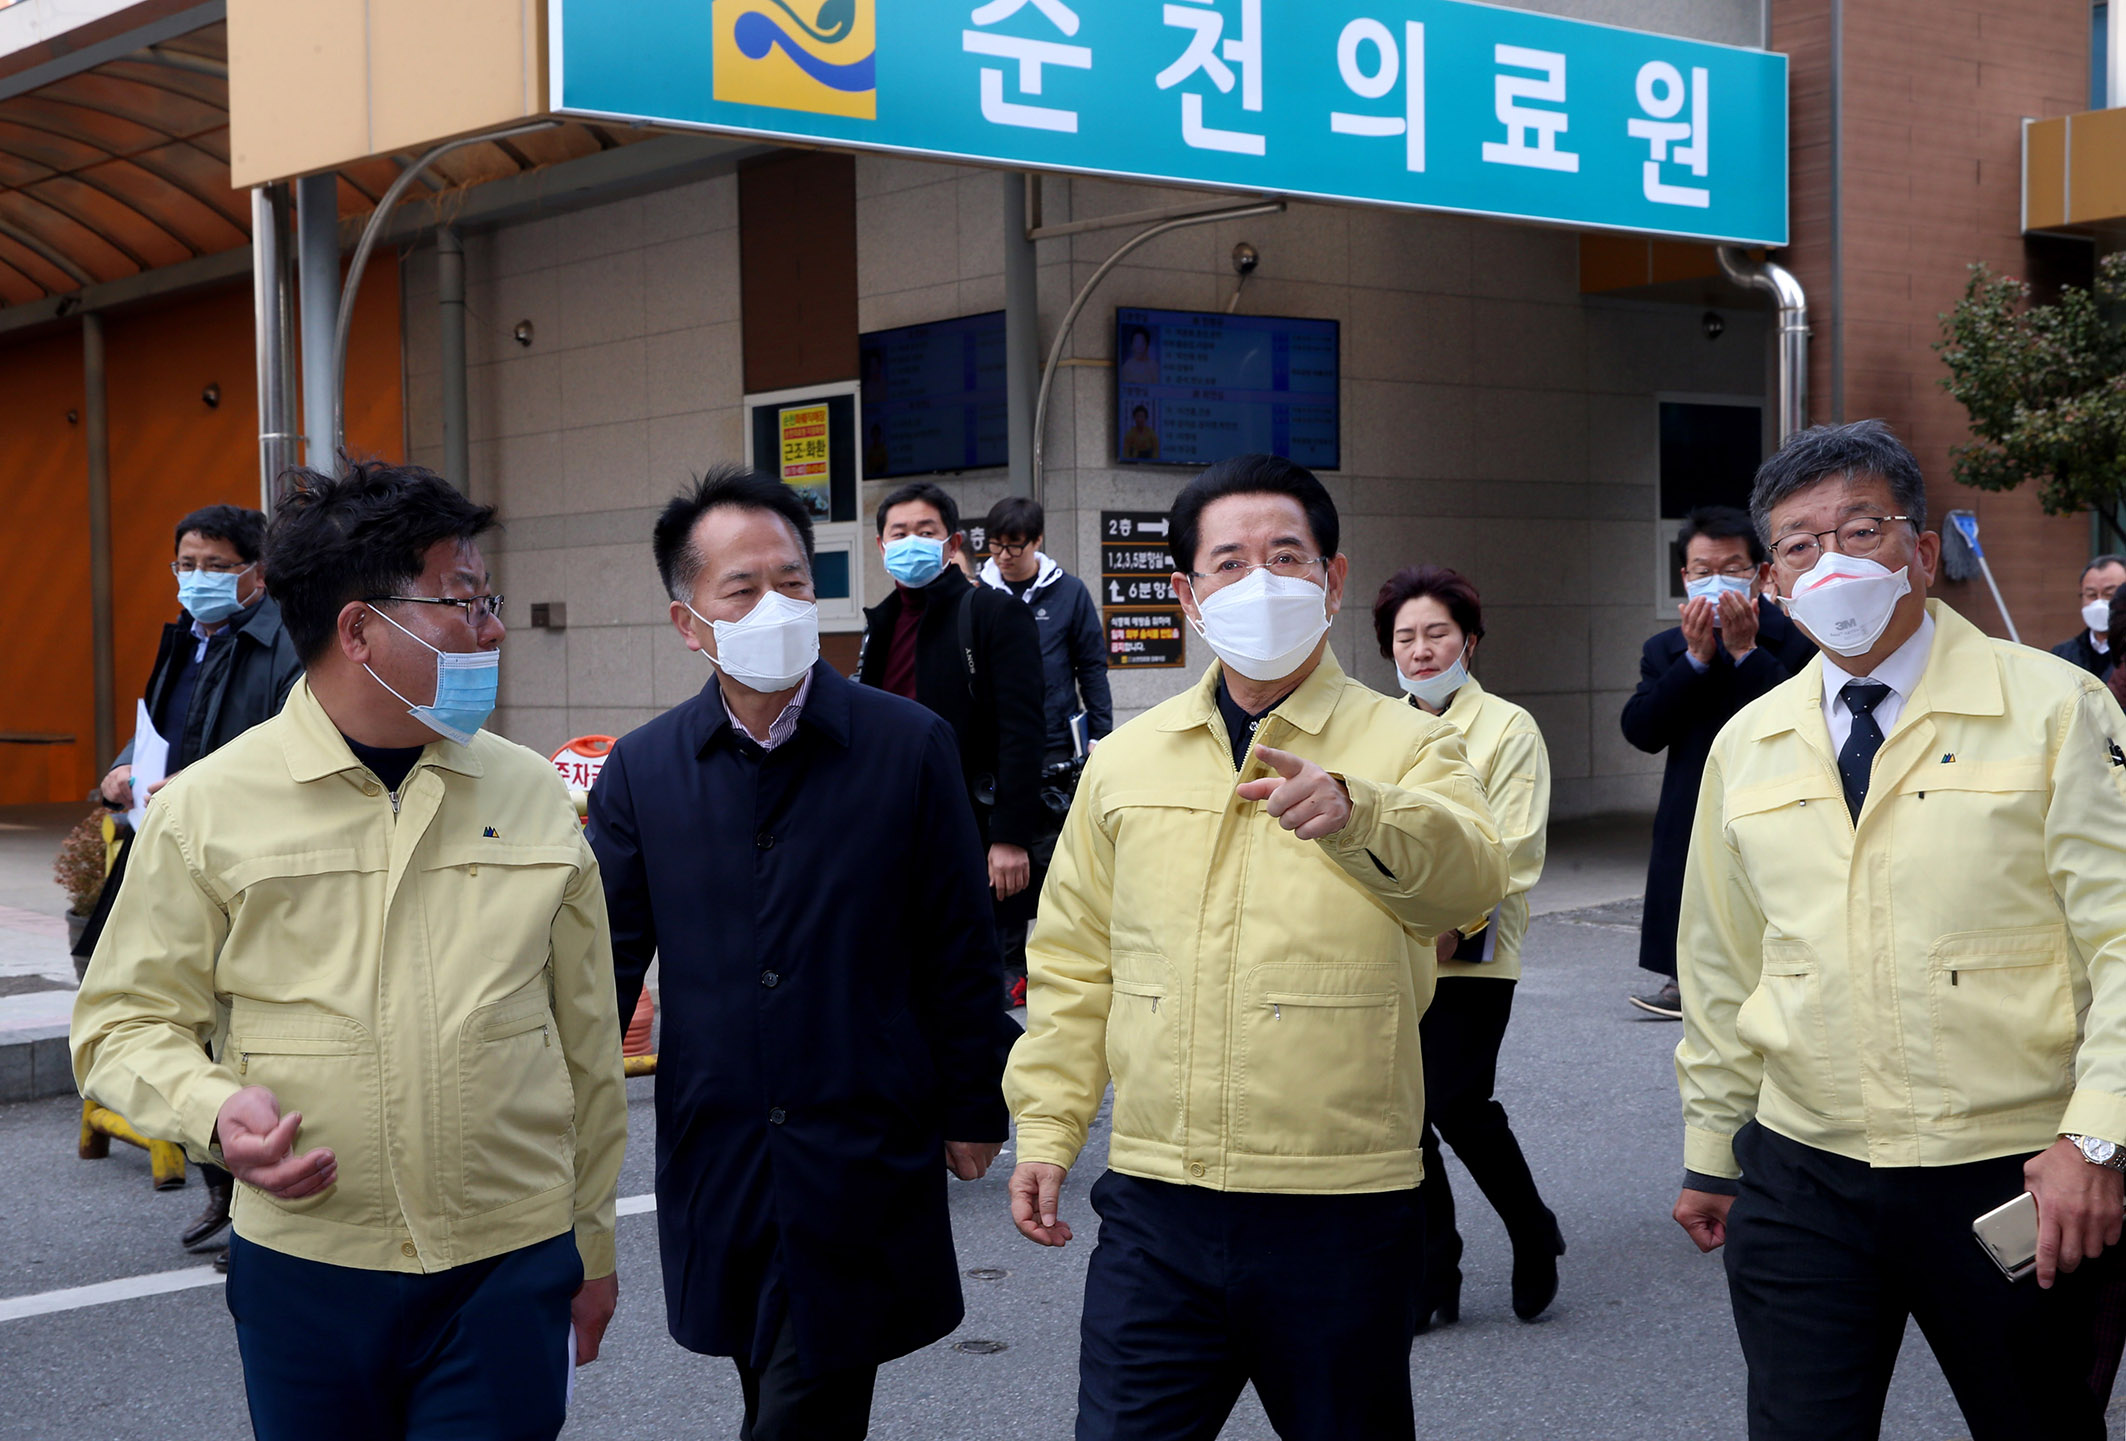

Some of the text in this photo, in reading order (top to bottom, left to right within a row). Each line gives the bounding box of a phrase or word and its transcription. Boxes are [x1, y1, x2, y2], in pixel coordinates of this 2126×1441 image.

[961, 0, 1711, 209] 순천의료원
[1109, 518, 1132, 537] 2층
[1834, 618, 1857, 631] 3M
[964, 647, 977, 675] SONY
